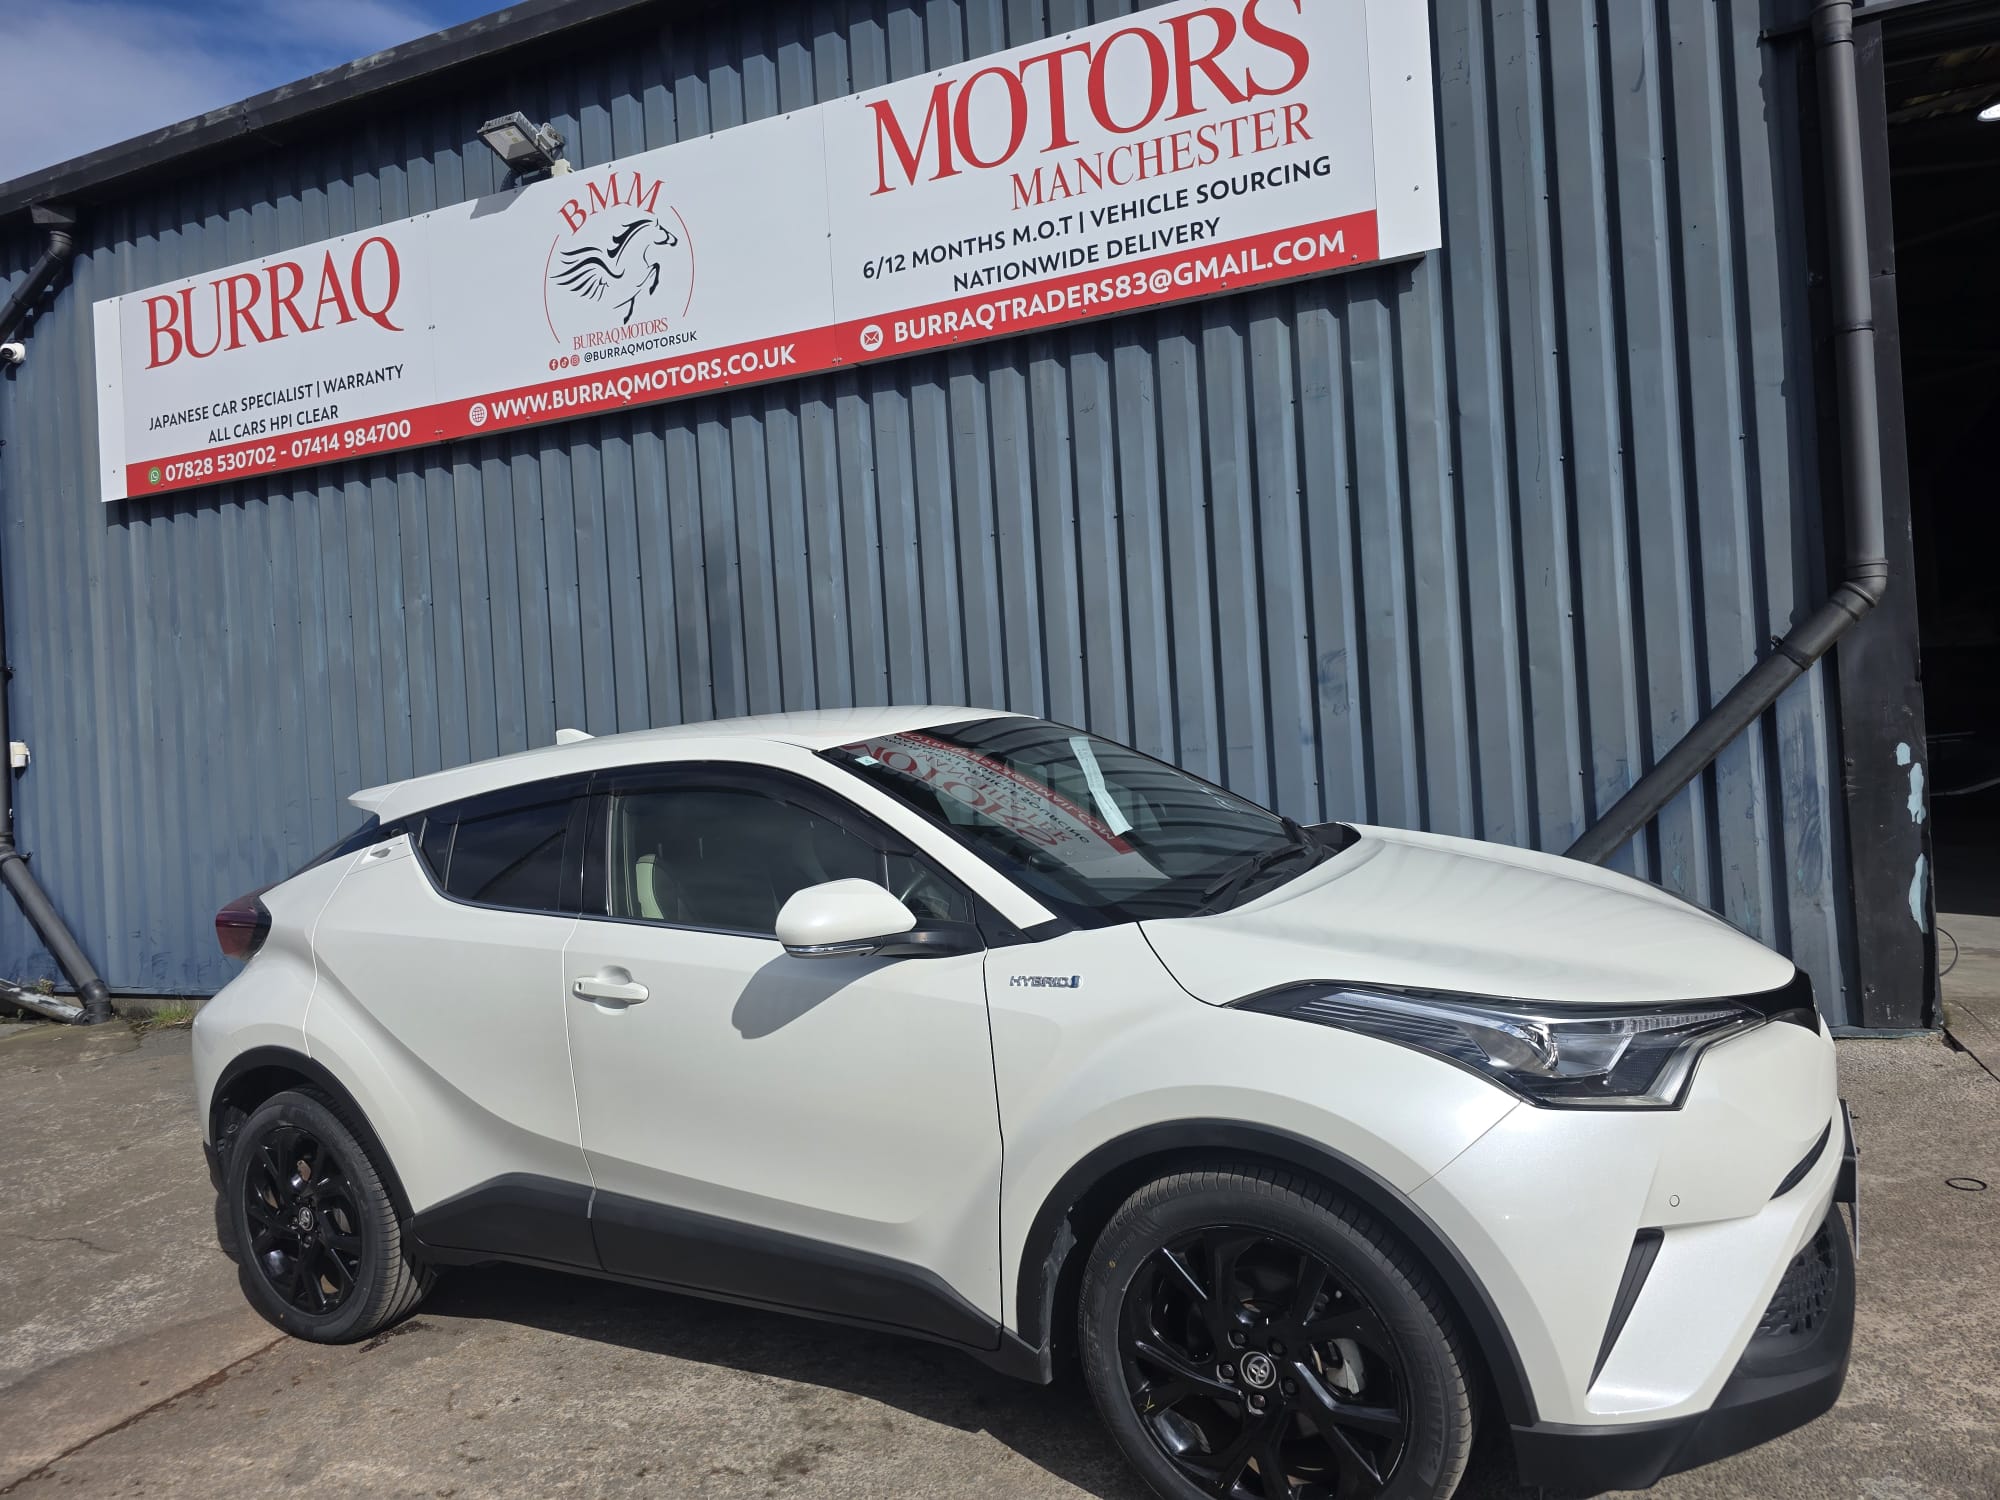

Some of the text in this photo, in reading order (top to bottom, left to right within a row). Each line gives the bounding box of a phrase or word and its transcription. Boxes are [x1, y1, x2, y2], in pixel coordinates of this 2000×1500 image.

[865, 0, 1309, 196] MOTORS
[1011, 102, 1314, 210] MANCHESTER
[558, 171, 665, 235] BMM
[862, 253, 906, 280] 6/12
[912, 230, 1005, 268] MONTHS
[1013, 215, 1072, 248] M.O.T
[1090, 189, 1189, 227] VEHICLE
[1196, 155, 1331, 205] SOURCING
[894, 229, 1345, 344] BURRAQTRADERS83@GMAIL.COM
[953, 217, 1221, 292] NATIONWIDE DELIVERY
[142, 236, 404, 370] BURRAQ
[491, 344, 796, 420] WWW.BURRAQMOTORS.CO.UK
[584, 331, 697, 363] @BURRAQMOTORSUK
[149, 405, 209, 431] JAPANESE
[213, 400, 237, 417] CAR
[241, 384, 313, 411] SPECIALIST
[324, 364, 404, 395] WARRANTY
[208, 405, 339, 443] ALL CARS HPI CLEAR
[165, 456, 214, 481] 07828
[217, 445, 277, 472] 530702
[291, 433, 340, 458] 07414
[344, 419, 411, 448] 984700
[1009, 975, 1070, 988] HYBRID
